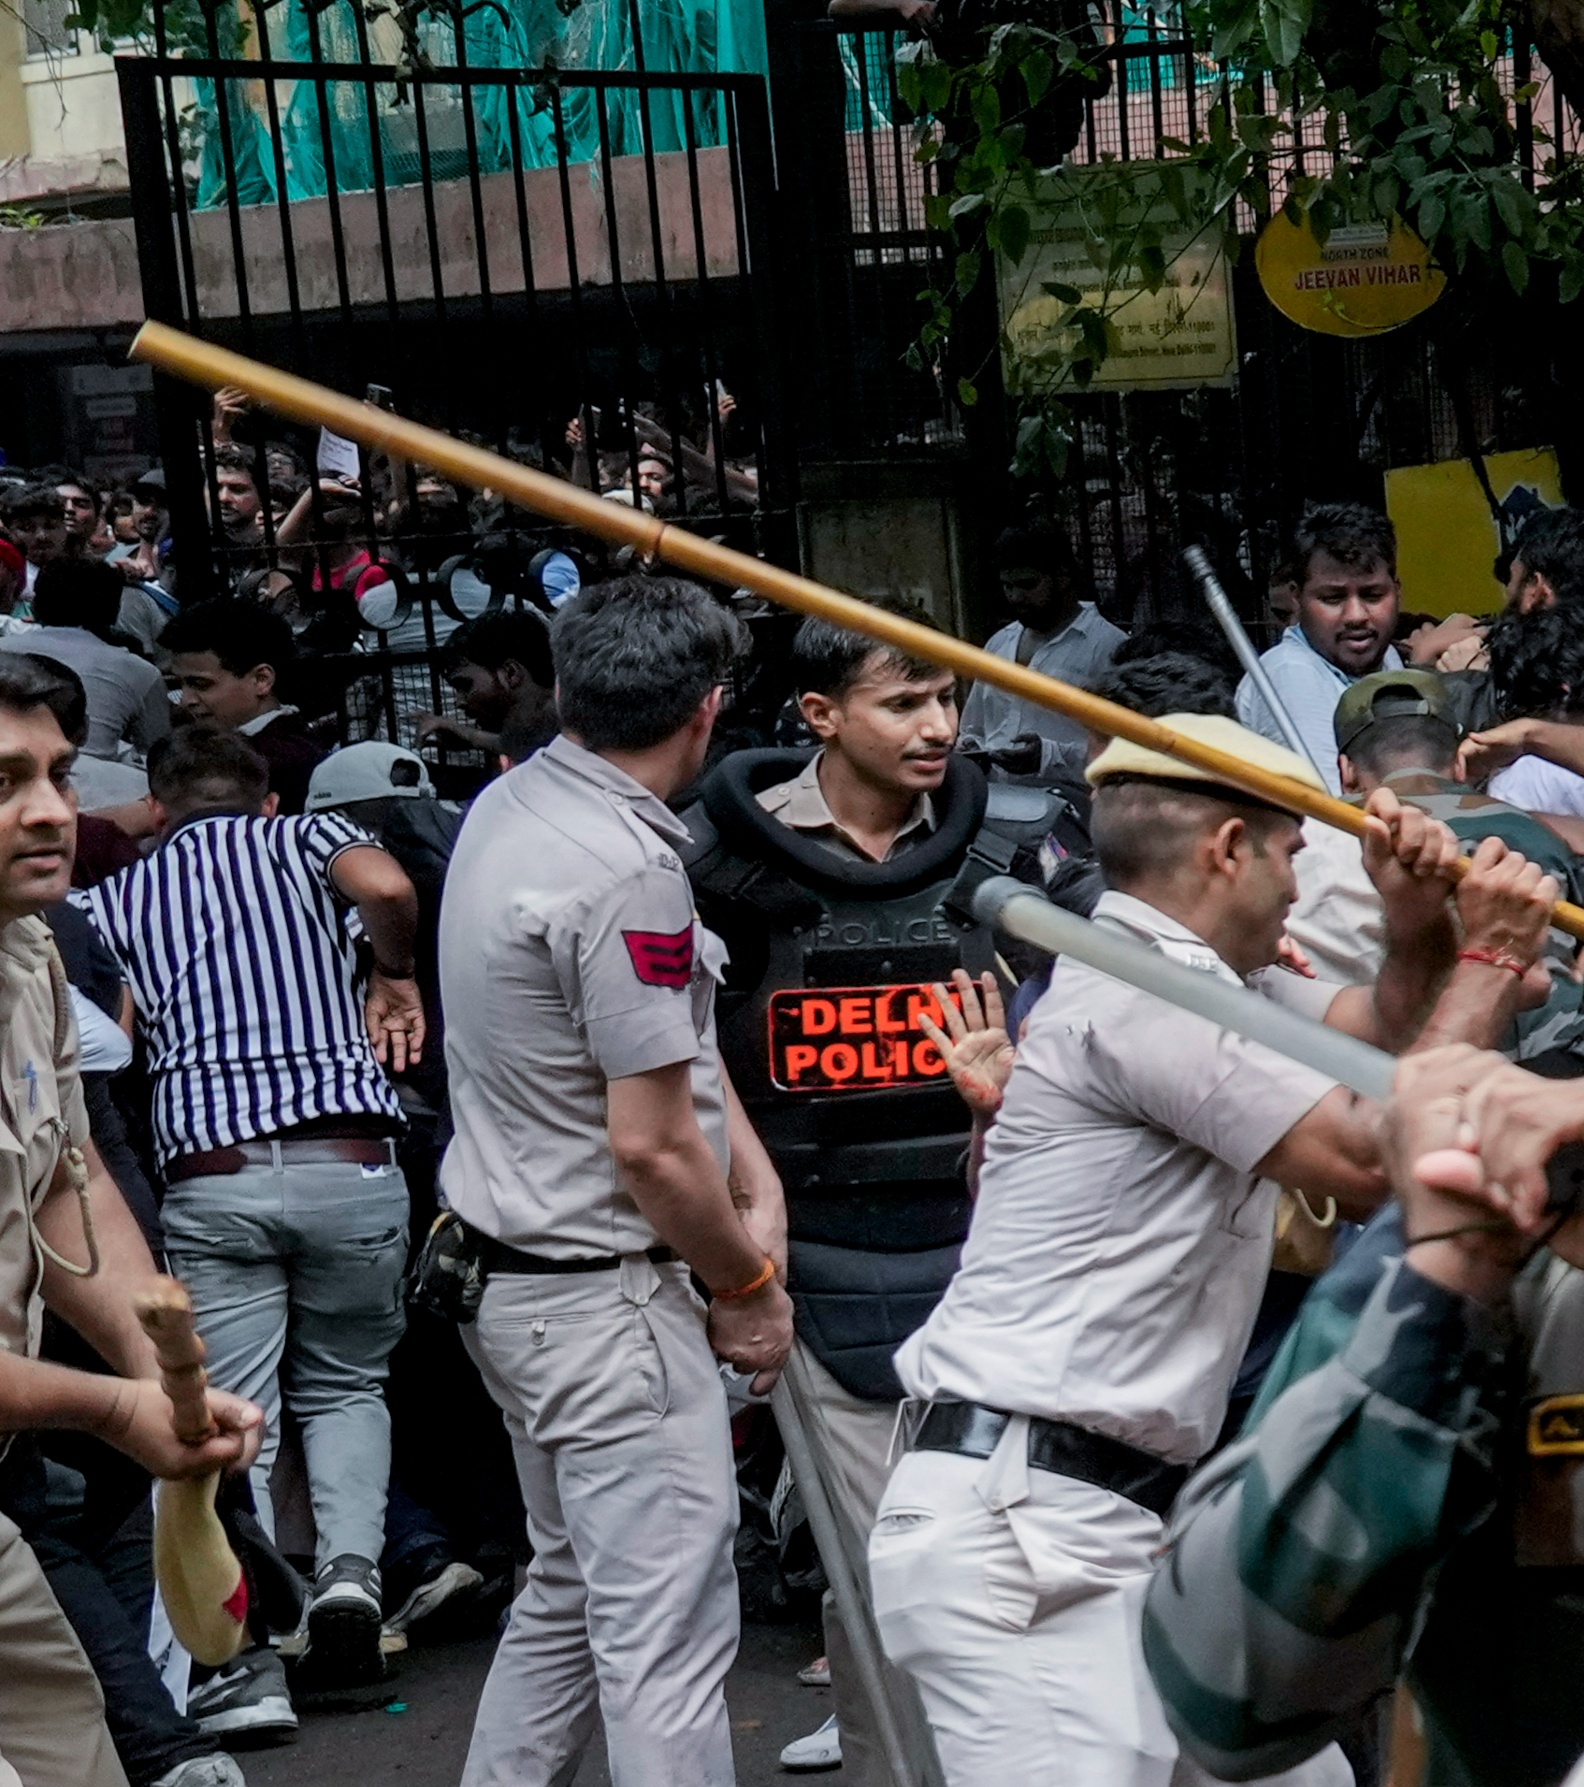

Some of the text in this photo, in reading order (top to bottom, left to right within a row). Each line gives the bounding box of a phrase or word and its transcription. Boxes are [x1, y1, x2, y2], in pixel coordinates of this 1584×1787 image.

[1360, 246, 1389, 259] ZONE
[1294, 264, 1421, 290] JEEVAN VIHAR
[813, 917, 958, 946] POLICE
[785, 1038, 948, 1082] POLIC
